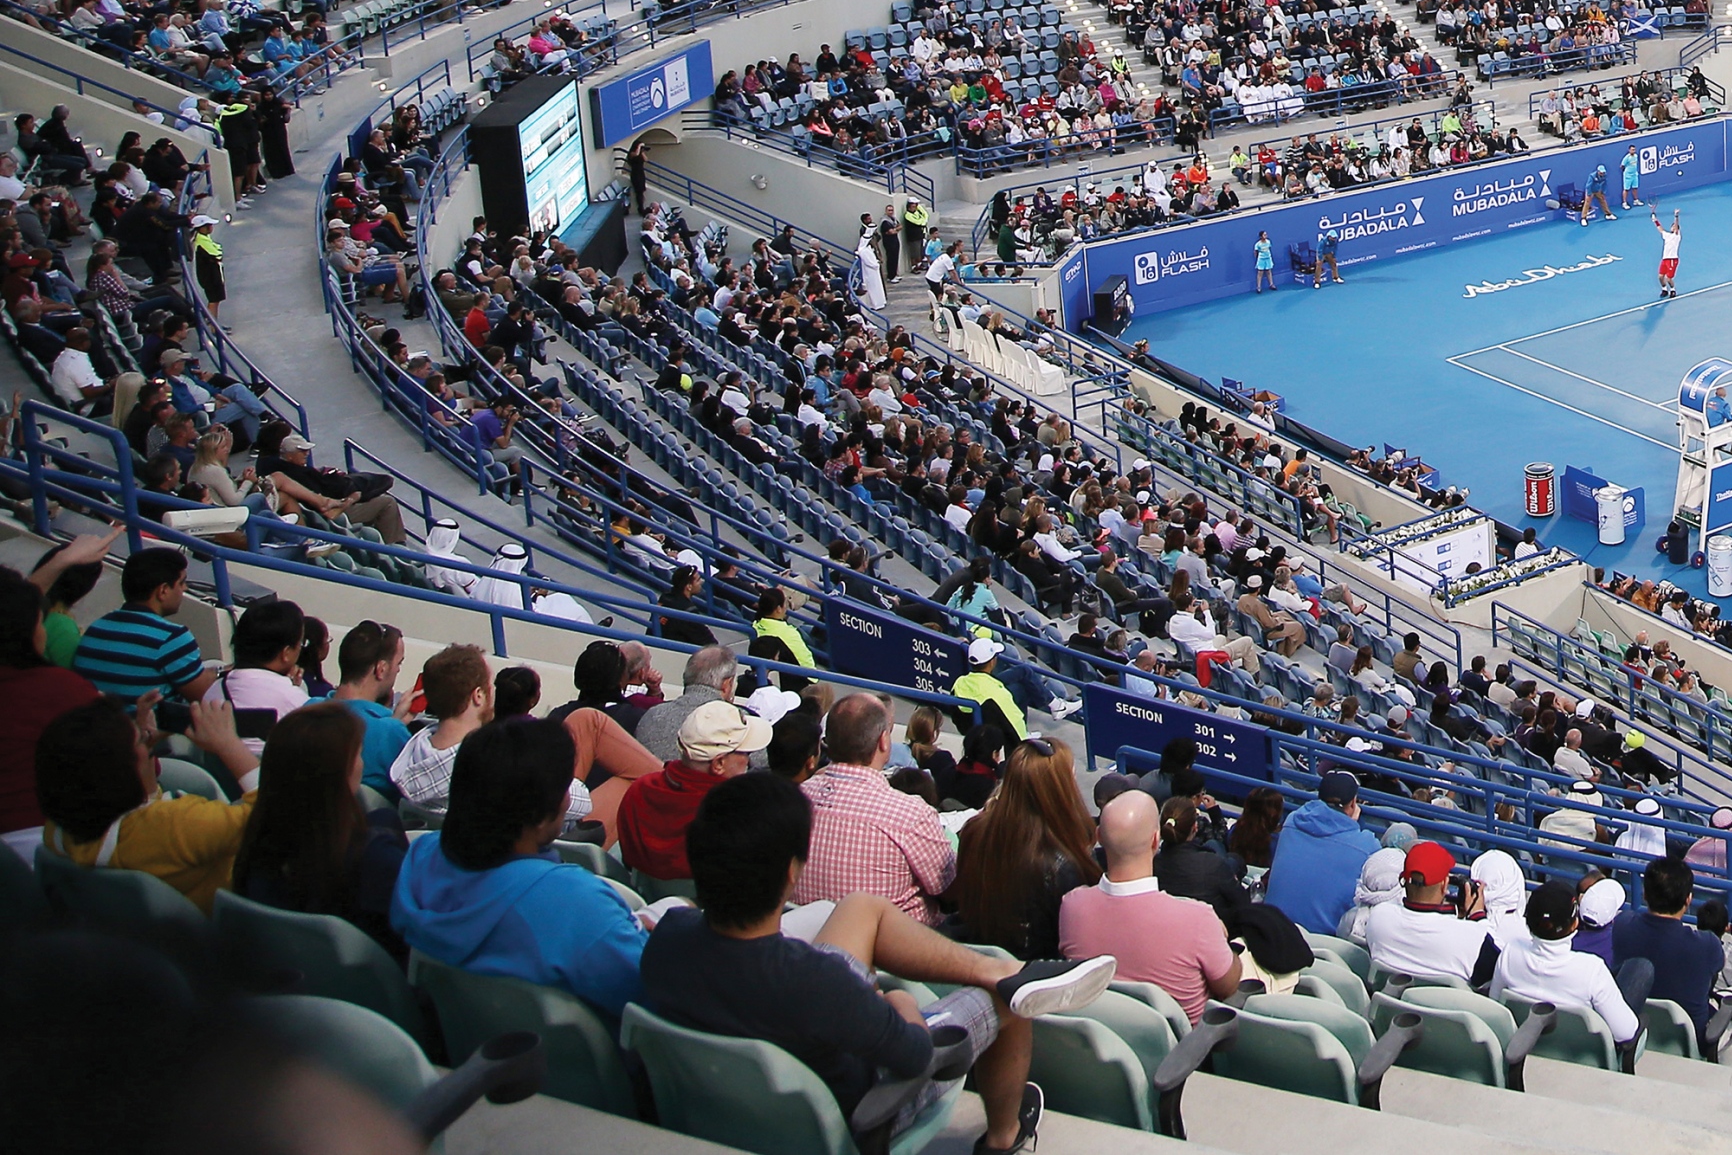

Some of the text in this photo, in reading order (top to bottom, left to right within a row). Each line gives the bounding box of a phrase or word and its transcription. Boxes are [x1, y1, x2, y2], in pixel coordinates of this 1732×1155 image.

[1658, 153, 1695, 169] FLASH
[1452, 188, 1537, 218] MUBADALA
[1161, 259, 1210, 278] FLASH
[1529, 481, 1539, 513] Wilson
[840, 612, 882, 639] SECTION
[912, 638, 931, 656] 303
[913, 657, 933, 675] 304
[915, 675, 935, 693] 305
[1115, 702, 1163, 724] SECTION
[1194, 723, 1215, 738] 301
[1195, 742, 1217, 757] 302
